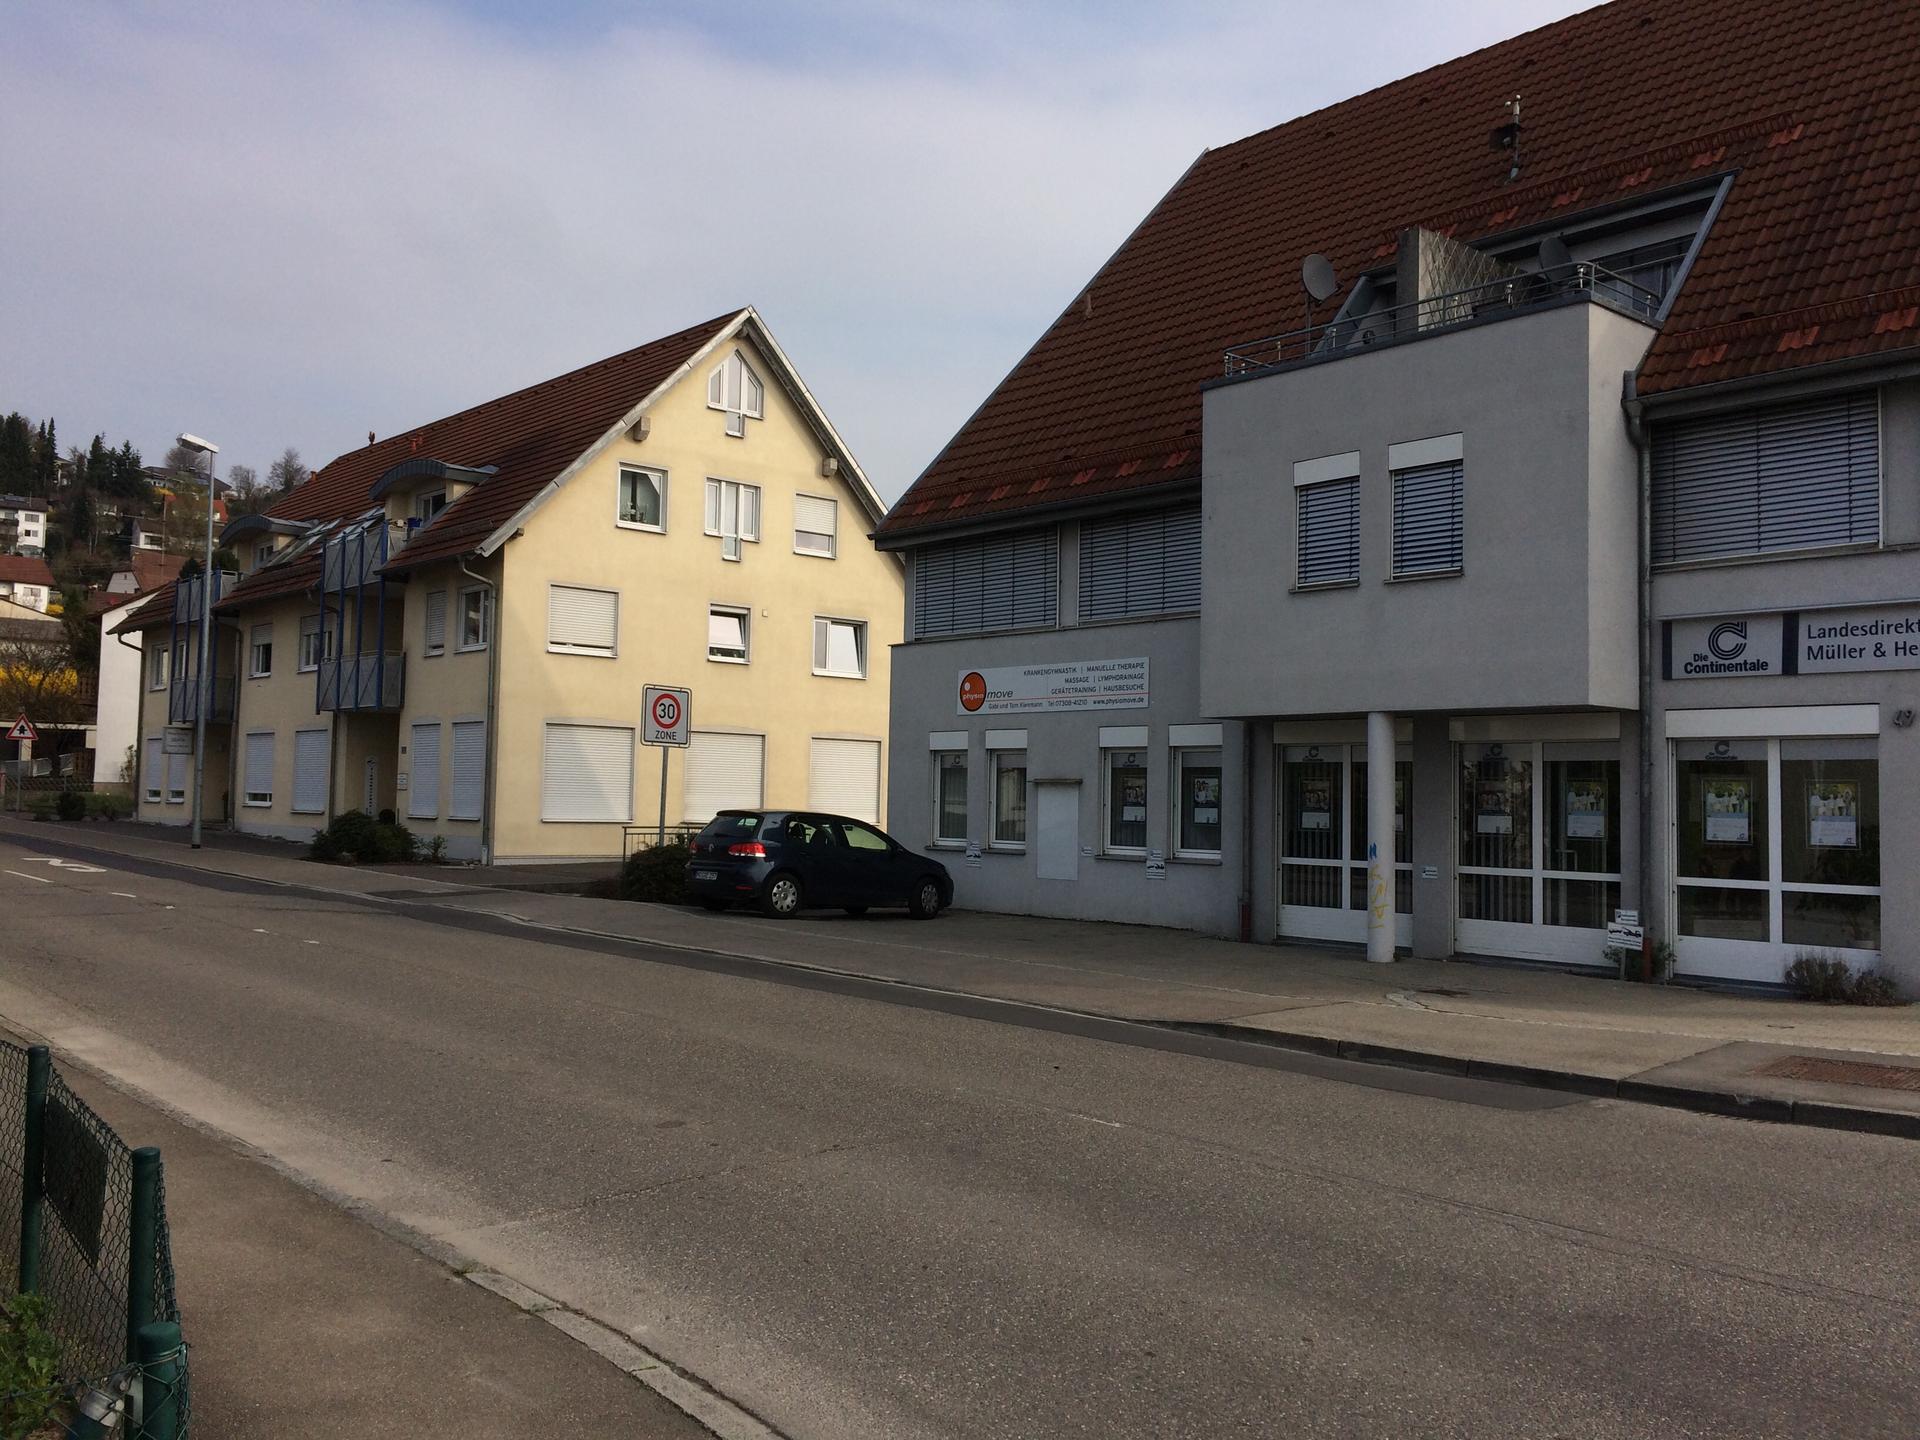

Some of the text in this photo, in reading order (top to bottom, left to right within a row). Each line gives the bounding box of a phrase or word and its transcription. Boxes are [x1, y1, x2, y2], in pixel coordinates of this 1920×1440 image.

[1807, 641, 1919, 661] Müller & He
[1693, 653, 1709, 663] Die
[1023, 661, 1145, 677] KRANKENGYMNASTIK MANUELLE THERAPIE
[1684, 658, 1769, 674] Continentale
[1064, 675, 1090, 684] MASSAGE
[1103, 682, 1145, 692] HAUSBESUCHE
[986, 690, 1013, 699] move
[1092, 696, 1145, 706] www.physiomove.de
[658, 703, 675, 719] 30
[655, 730, 677, 740] ZONE
